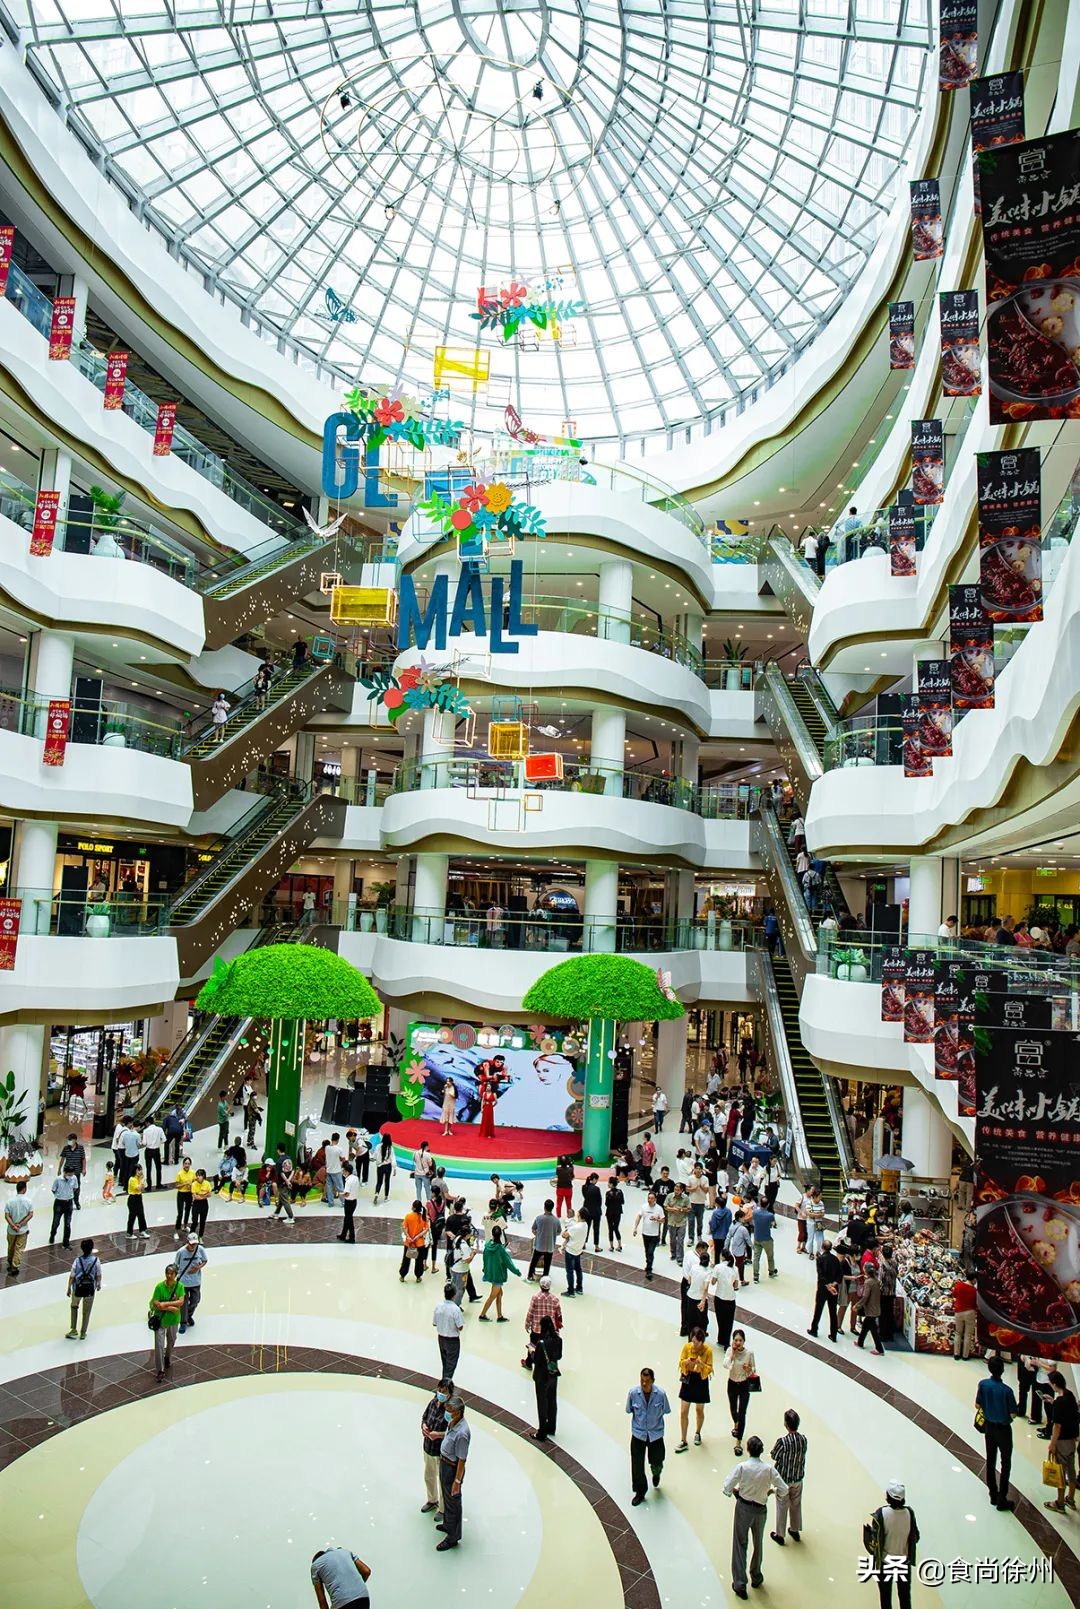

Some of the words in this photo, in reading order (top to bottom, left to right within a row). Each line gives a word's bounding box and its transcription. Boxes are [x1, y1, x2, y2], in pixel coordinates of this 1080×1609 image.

[984, 182, 1080, 227] 美味小锅
[979, 480, 1040, 500] 美味小锅
[397, 558, 539, 654] MALL
[77, 841, 94, 851] POLO
[94, 843, 114, 854] SPORT
[977, 1086, 1080, 1123] 美味小锅
[981, 1125, 1027, 1139] 传统美食
